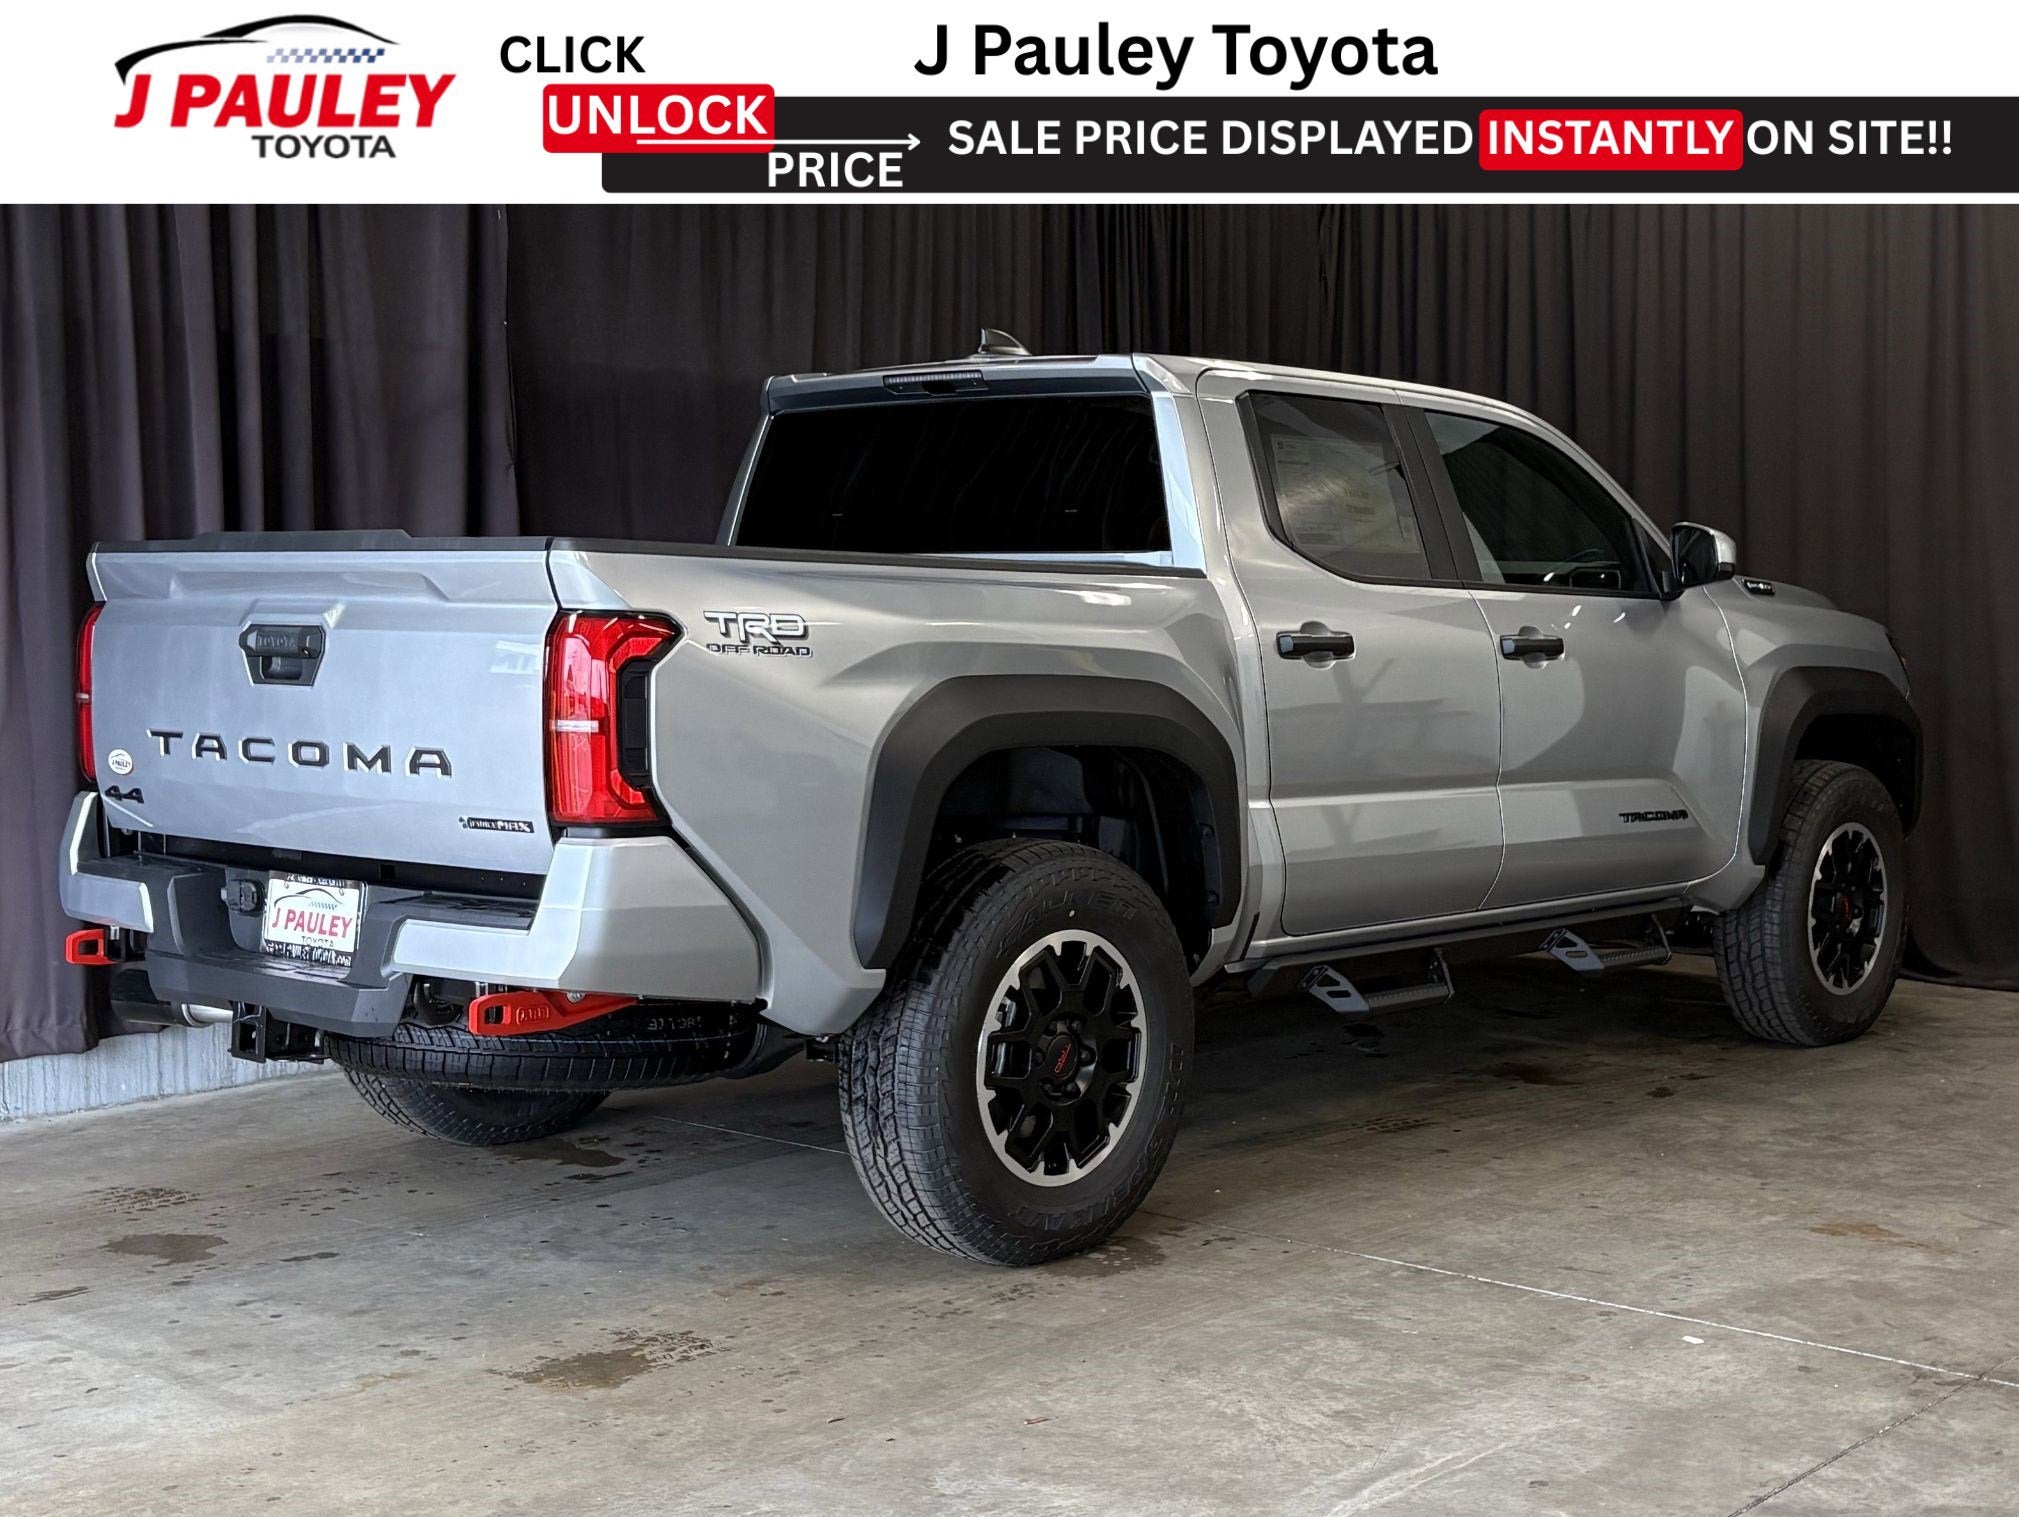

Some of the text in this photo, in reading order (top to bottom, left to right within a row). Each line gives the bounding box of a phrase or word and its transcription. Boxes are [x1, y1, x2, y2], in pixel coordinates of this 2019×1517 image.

[703, 610, 808, 645] TRD
[706, 642, 813, 657] OFF ROAD
[146, 728, 453, 779] TACOMA
[272, 907, 353, 939] J PAULEY
[301, 935, 334, 948] TOYOTA
